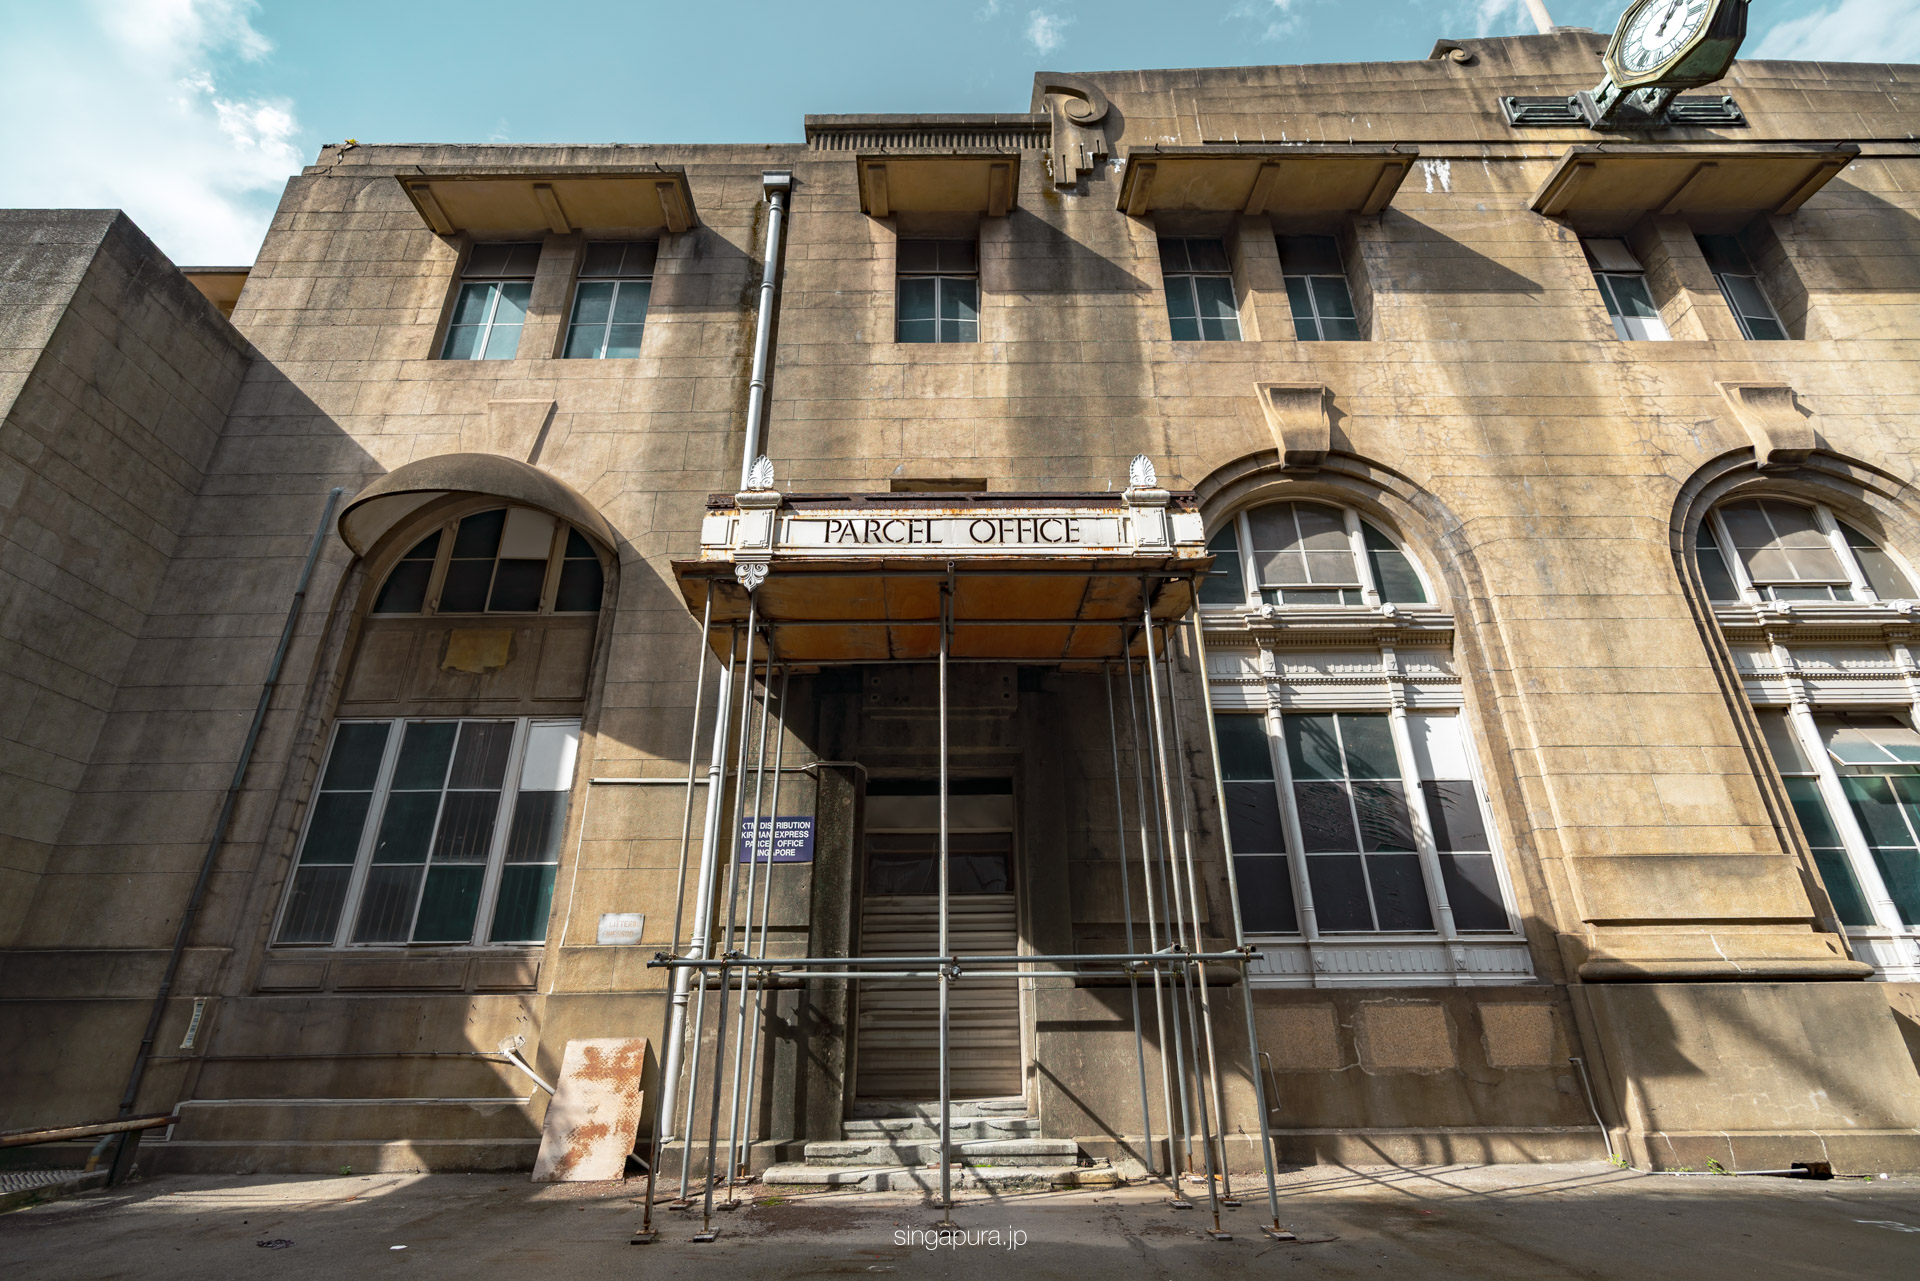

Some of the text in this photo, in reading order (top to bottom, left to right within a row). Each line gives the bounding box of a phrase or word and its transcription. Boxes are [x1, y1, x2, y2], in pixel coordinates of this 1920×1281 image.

[823, 518, 1080, 544] PARCEL OFFICE
[760, 821, 811, 830] DISRIBUTION
[741, 830, 809, 839] KIRAN EXPRESS
[745, 839, 804, 848] PACE OFFICE
[756, 848, 796, 857] INGPORE
